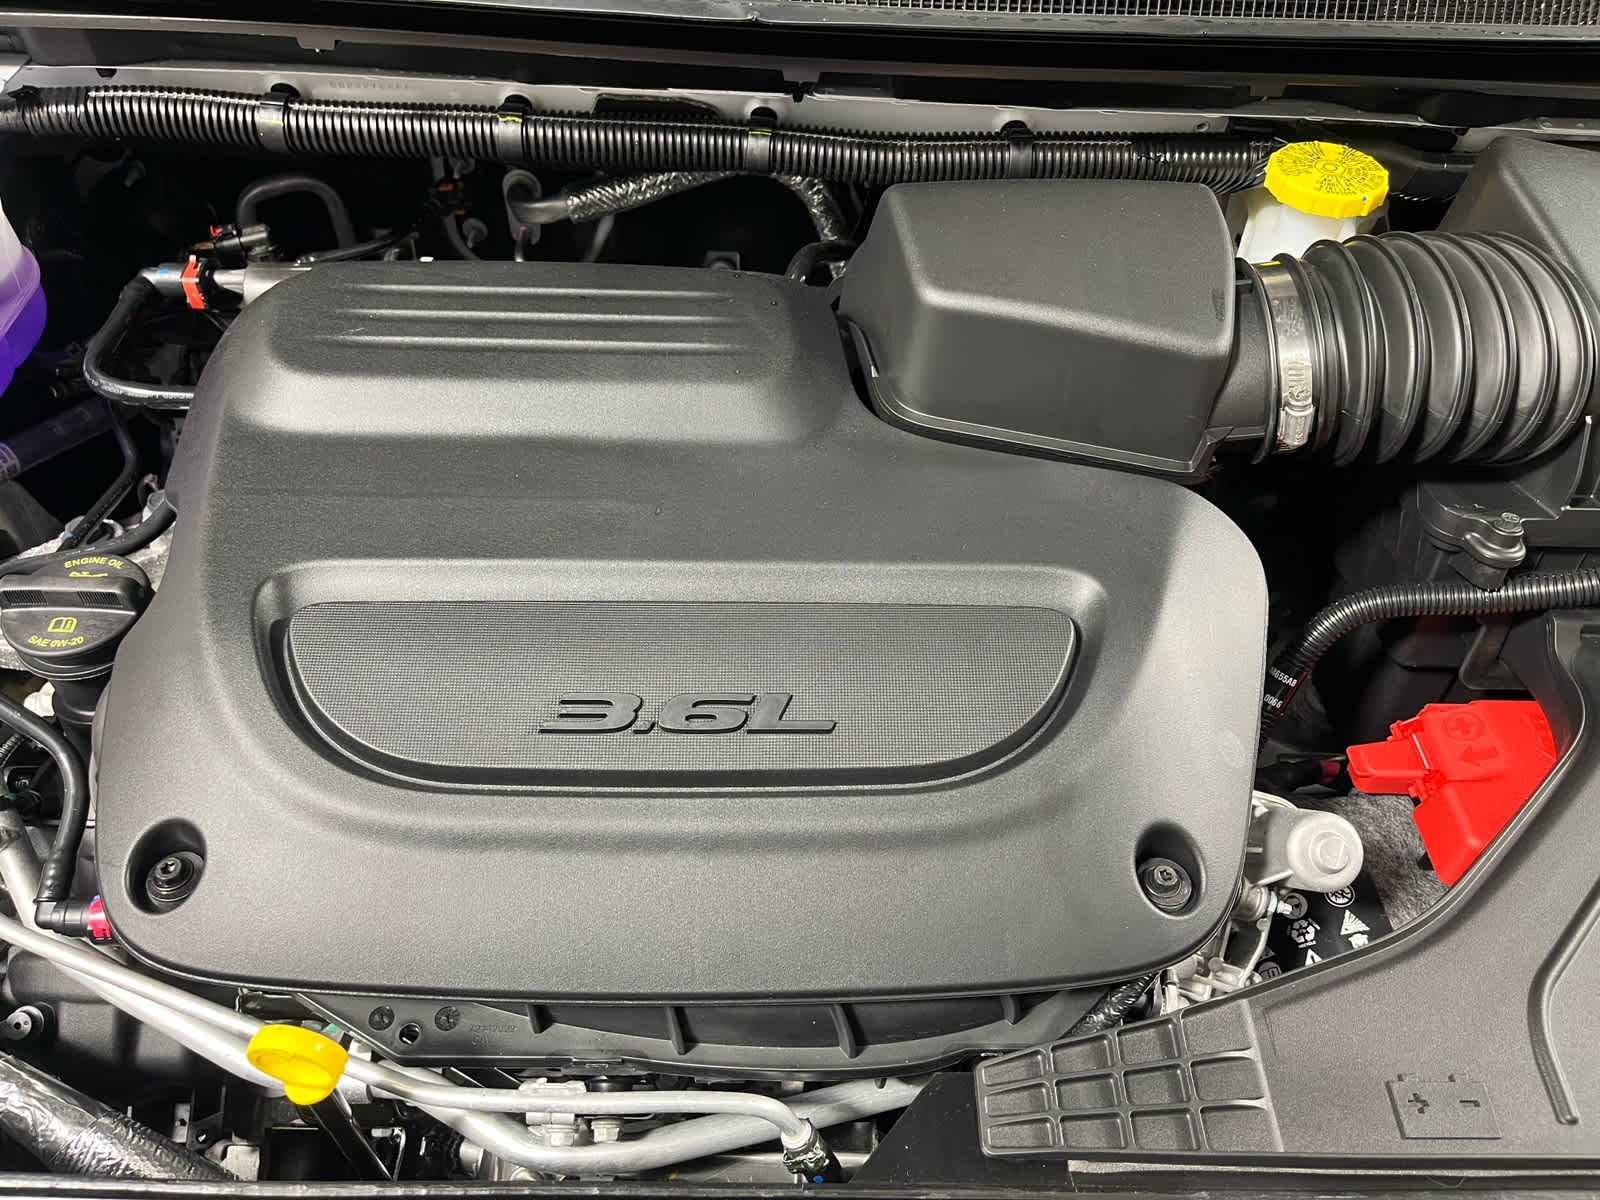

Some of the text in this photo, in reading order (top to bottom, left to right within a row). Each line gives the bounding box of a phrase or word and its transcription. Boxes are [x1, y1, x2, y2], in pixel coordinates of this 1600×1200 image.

[64, 557, 124, 569] ENGINE OIL
[28, 635, 84, 648] SAE 0W-20
[538, 692, 838, 735] 3.6L
